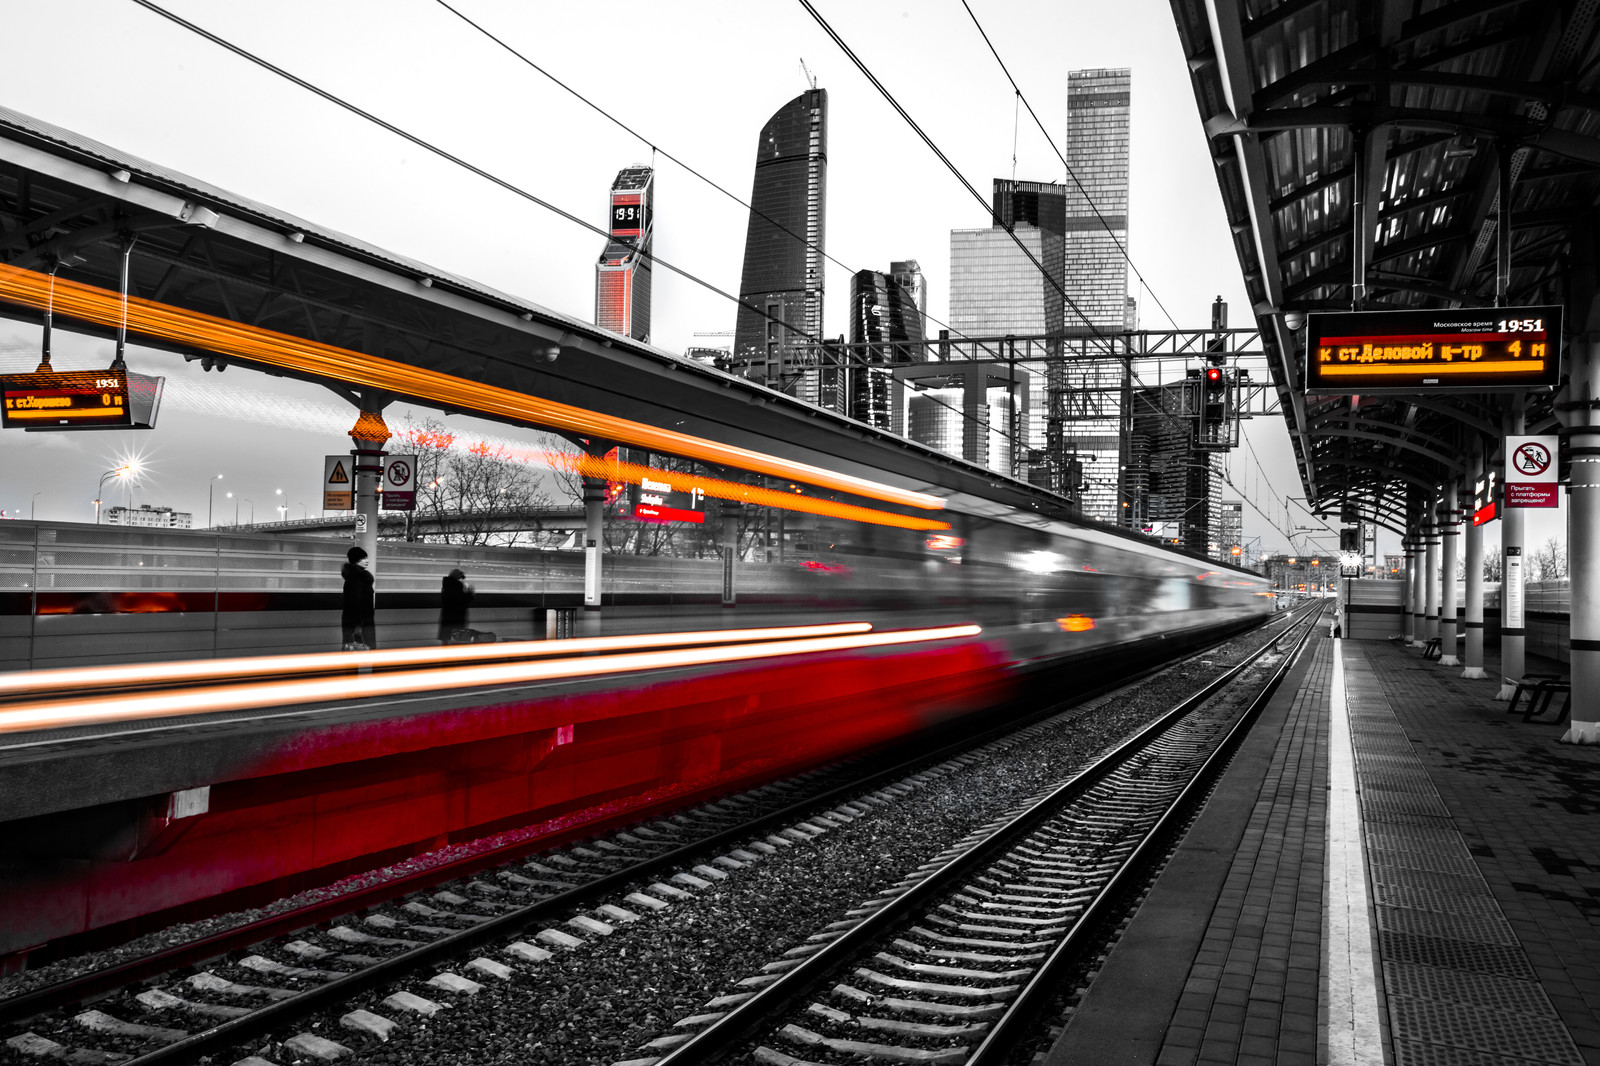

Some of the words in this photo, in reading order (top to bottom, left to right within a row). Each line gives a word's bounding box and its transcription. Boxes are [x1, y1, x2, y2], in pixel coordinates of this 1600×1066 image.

[1498, 319, 1544, 333] 19:51
[1508, 340, 1521, 357] 4
[95, 379, 119, 388] 19:51
